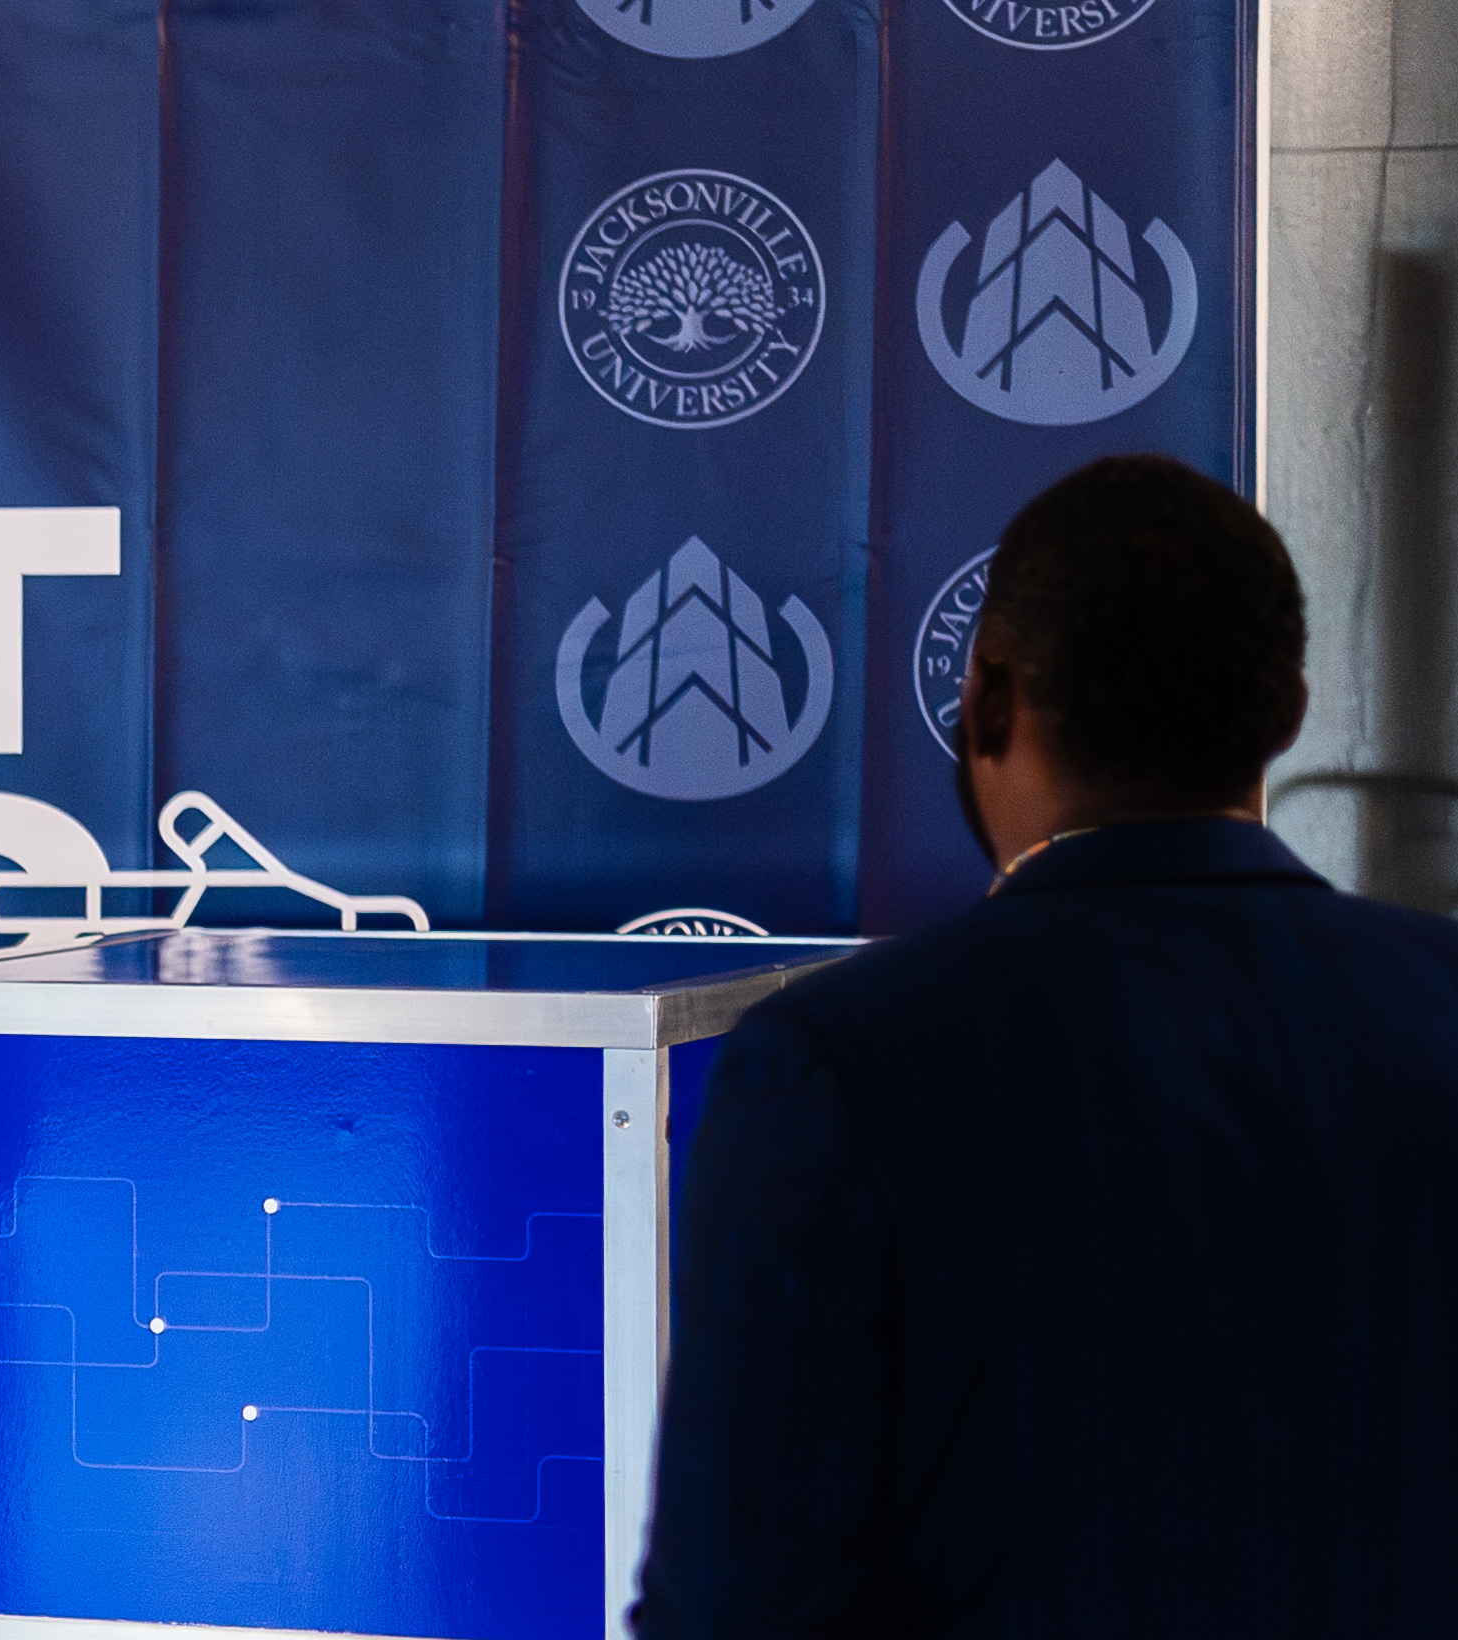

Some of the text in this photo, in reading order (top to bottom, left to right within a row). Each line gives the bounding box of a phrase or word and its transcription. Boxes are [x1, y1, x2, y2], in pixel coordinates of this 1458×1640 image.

[971, 0, 1138, 38] IVERSI
[576, 181, 807, 285] JACKSONVILLE
[582, 329, 800, 416] UNIVERSITY
